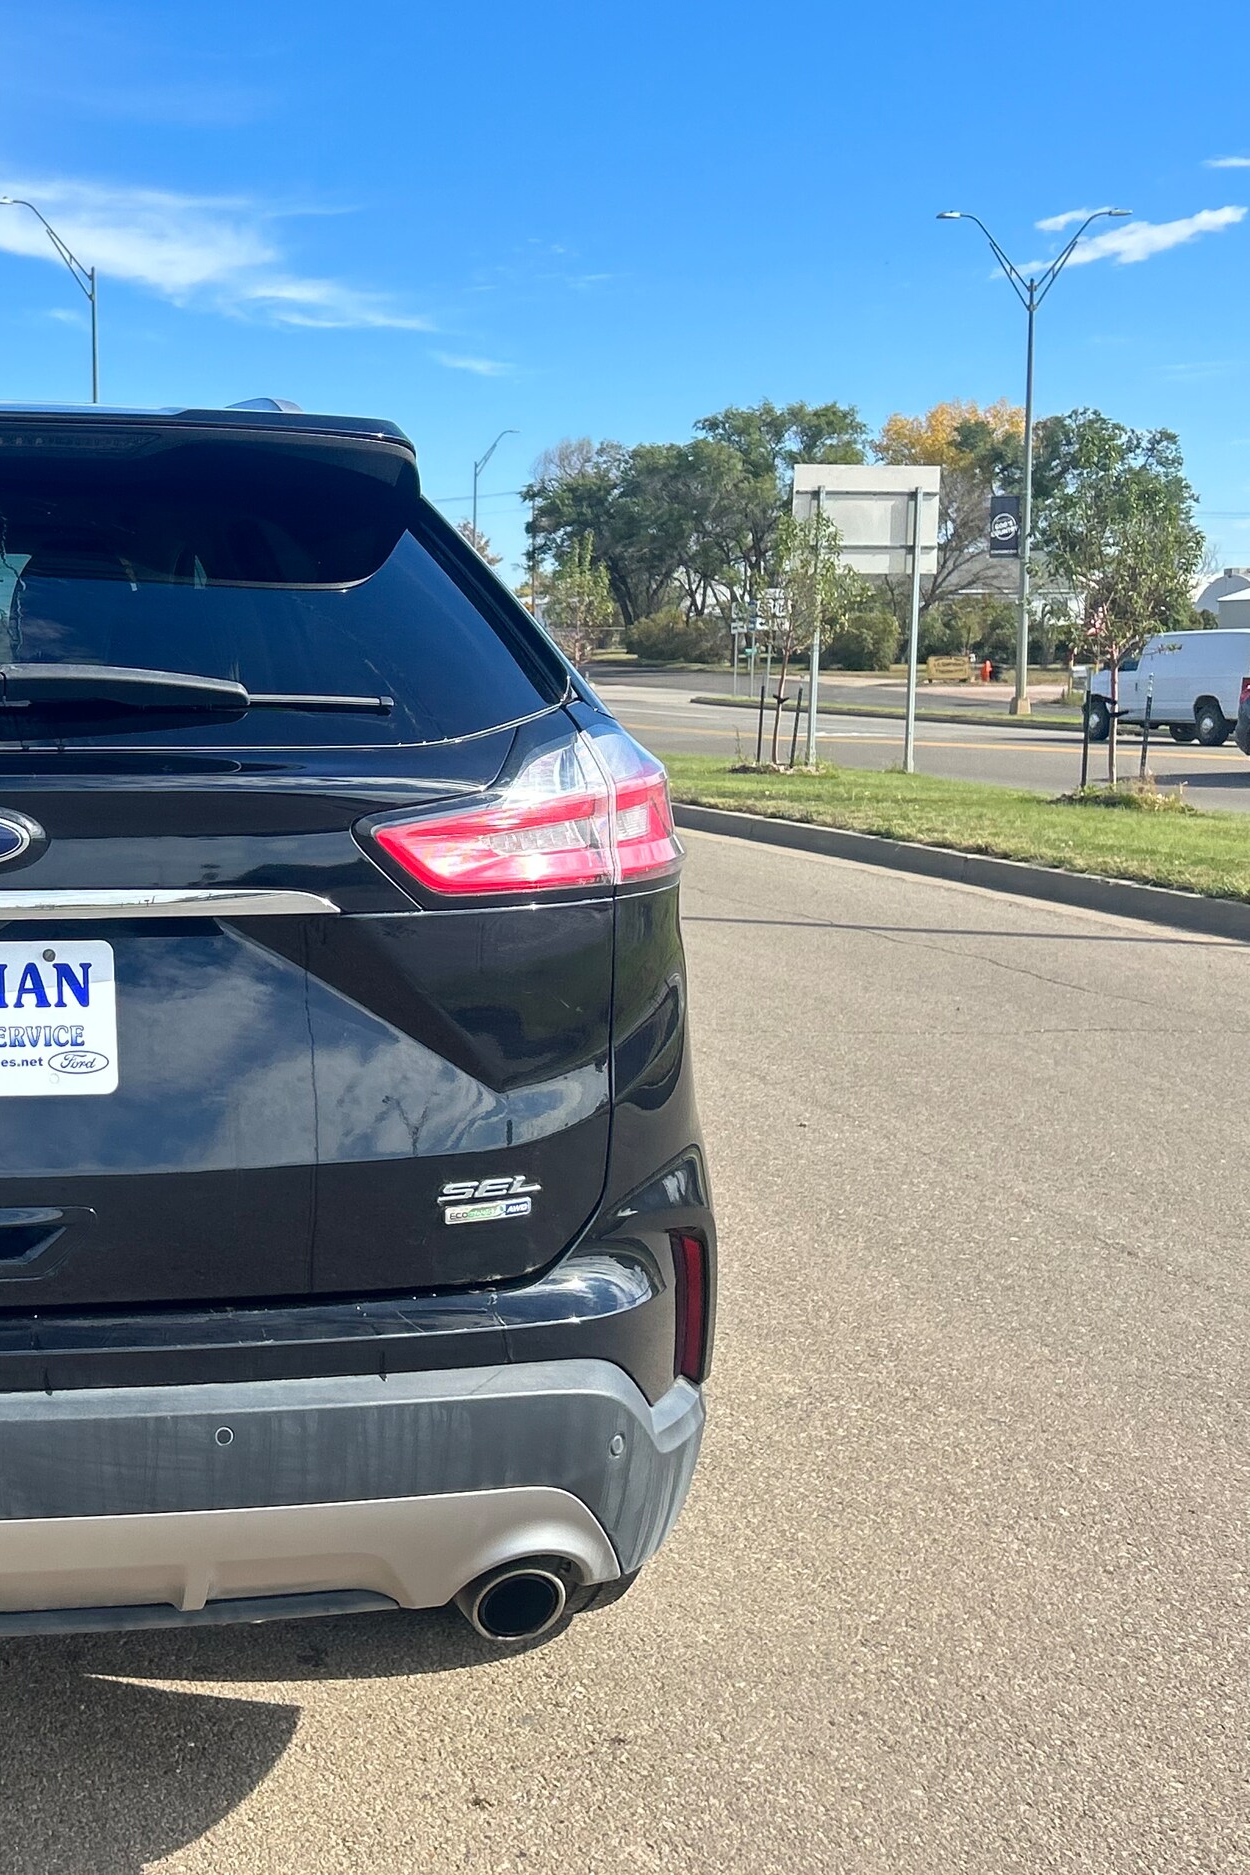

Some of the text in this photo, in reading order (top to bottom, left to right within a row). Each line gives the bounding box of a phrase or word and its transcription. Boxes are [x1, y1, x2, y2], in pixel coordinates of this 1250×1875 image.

[59, 1054, 97, 1070] Ford
[437, 1175, 542, 1204] SEL
[507, 1202, 529, 1213] AWD
